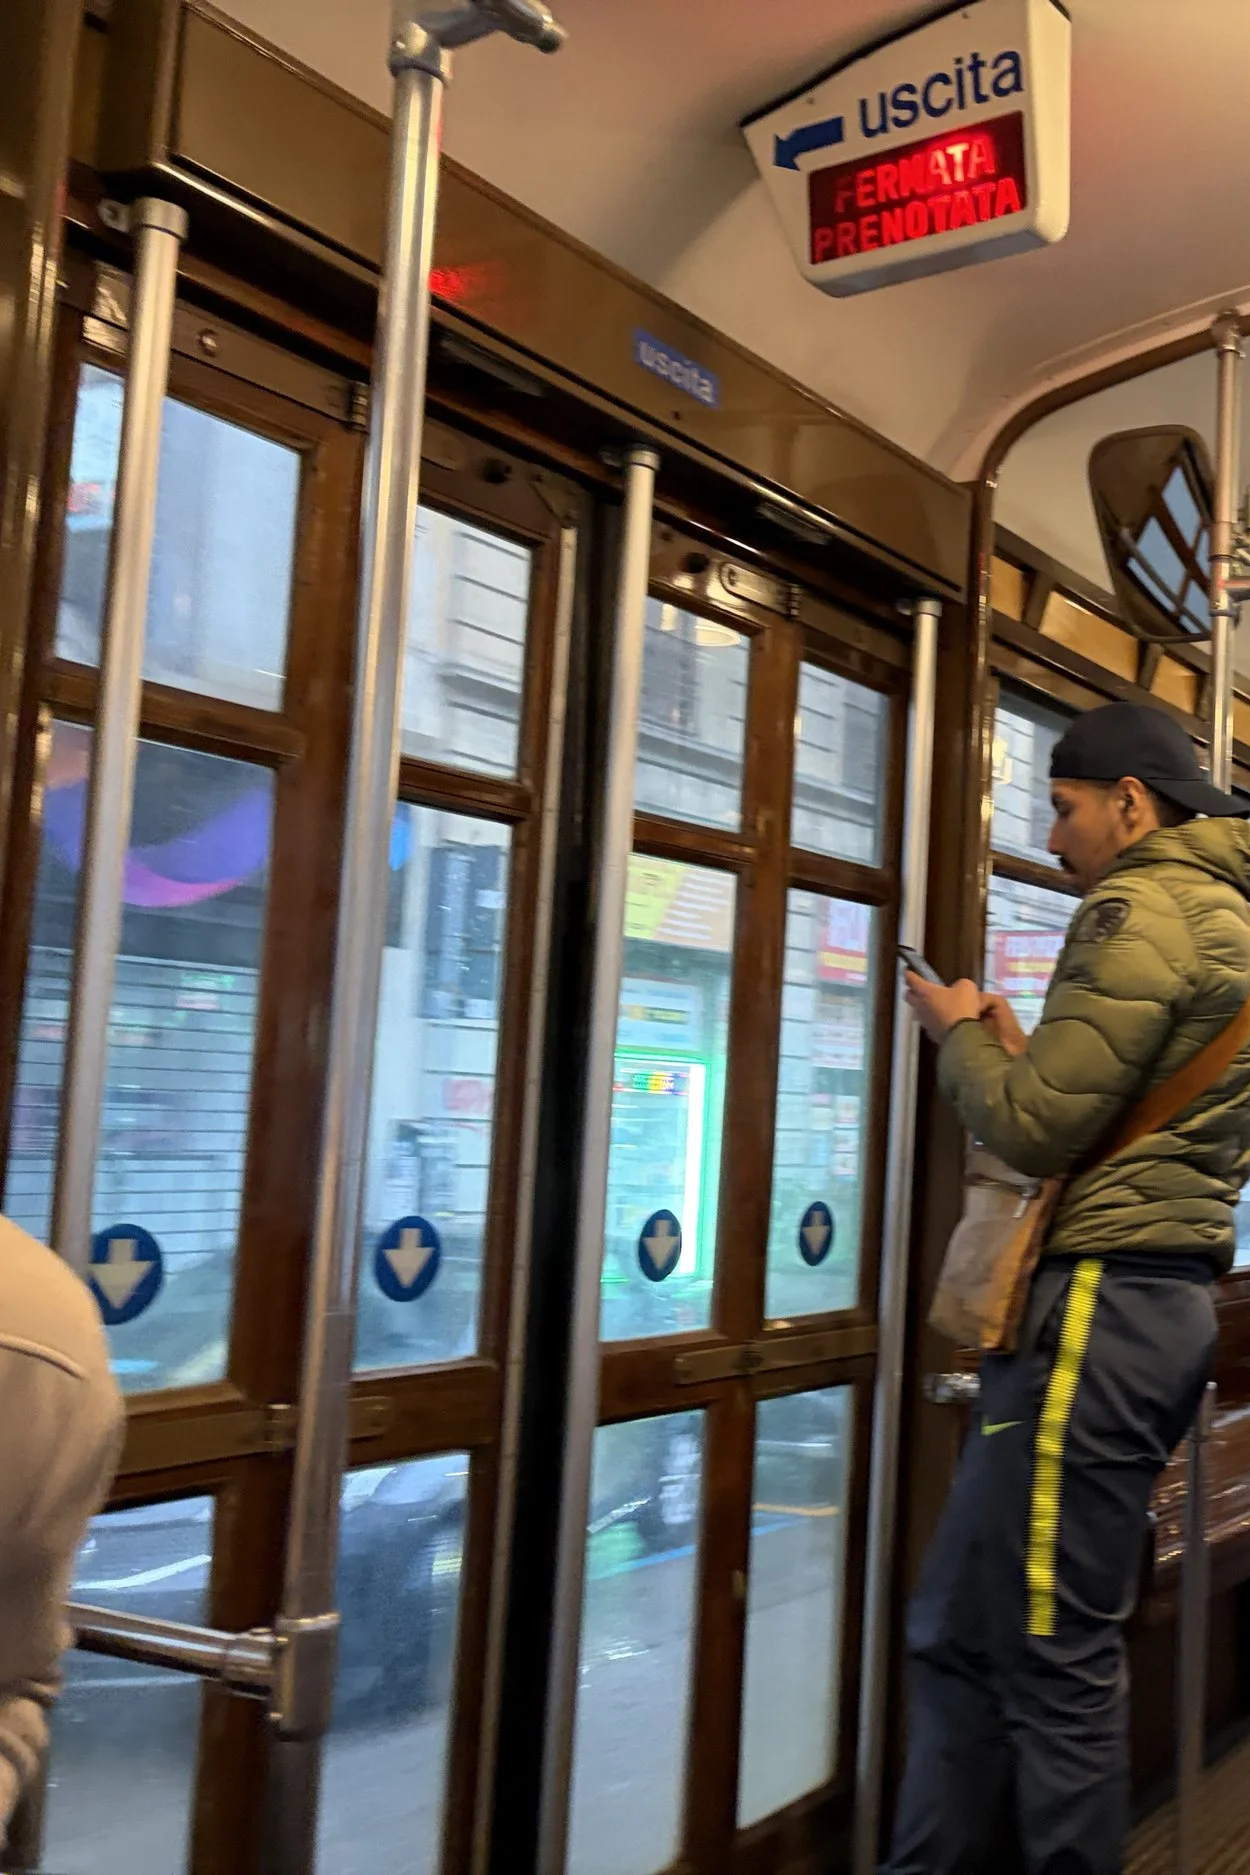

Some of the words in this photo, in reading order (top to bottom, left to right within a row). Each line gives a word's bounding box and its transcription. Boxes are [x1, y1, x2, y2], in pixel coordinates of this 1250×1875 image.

[858, 50, 1024, 138] uscita
[835, 138, 996, 214] FERMATA
[812, 177, 1021, 263] PRENOTATA
